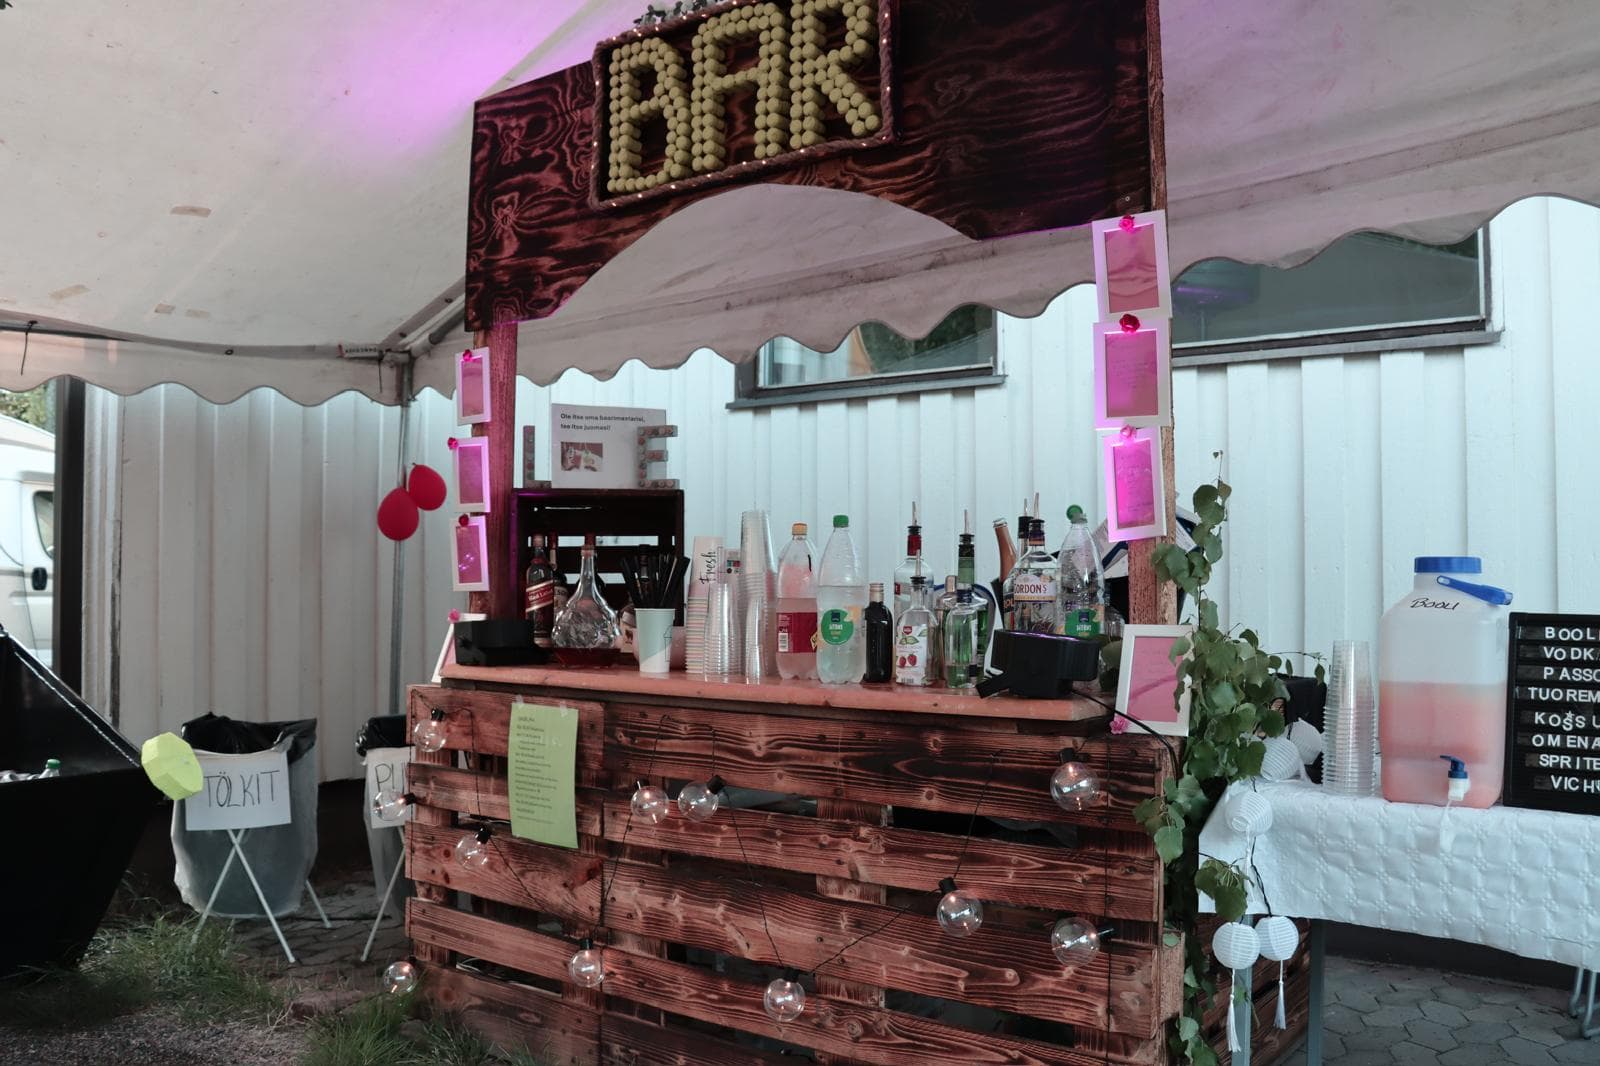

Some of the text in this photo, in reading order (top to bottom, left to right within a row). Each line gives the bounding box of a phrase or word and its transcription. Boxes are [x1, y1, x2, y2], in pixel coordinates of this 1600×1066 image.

[607, 0, 881, 192] BAR
[699, 551, 716, 584] Fresh
[1527, 687, 1600, 703] TUOREM
[1532, 734, 1600, 750] OMENA
[1539, 754, 1600, 771] SPRITE
[203, 770, 280, 808] TÖLKIT
